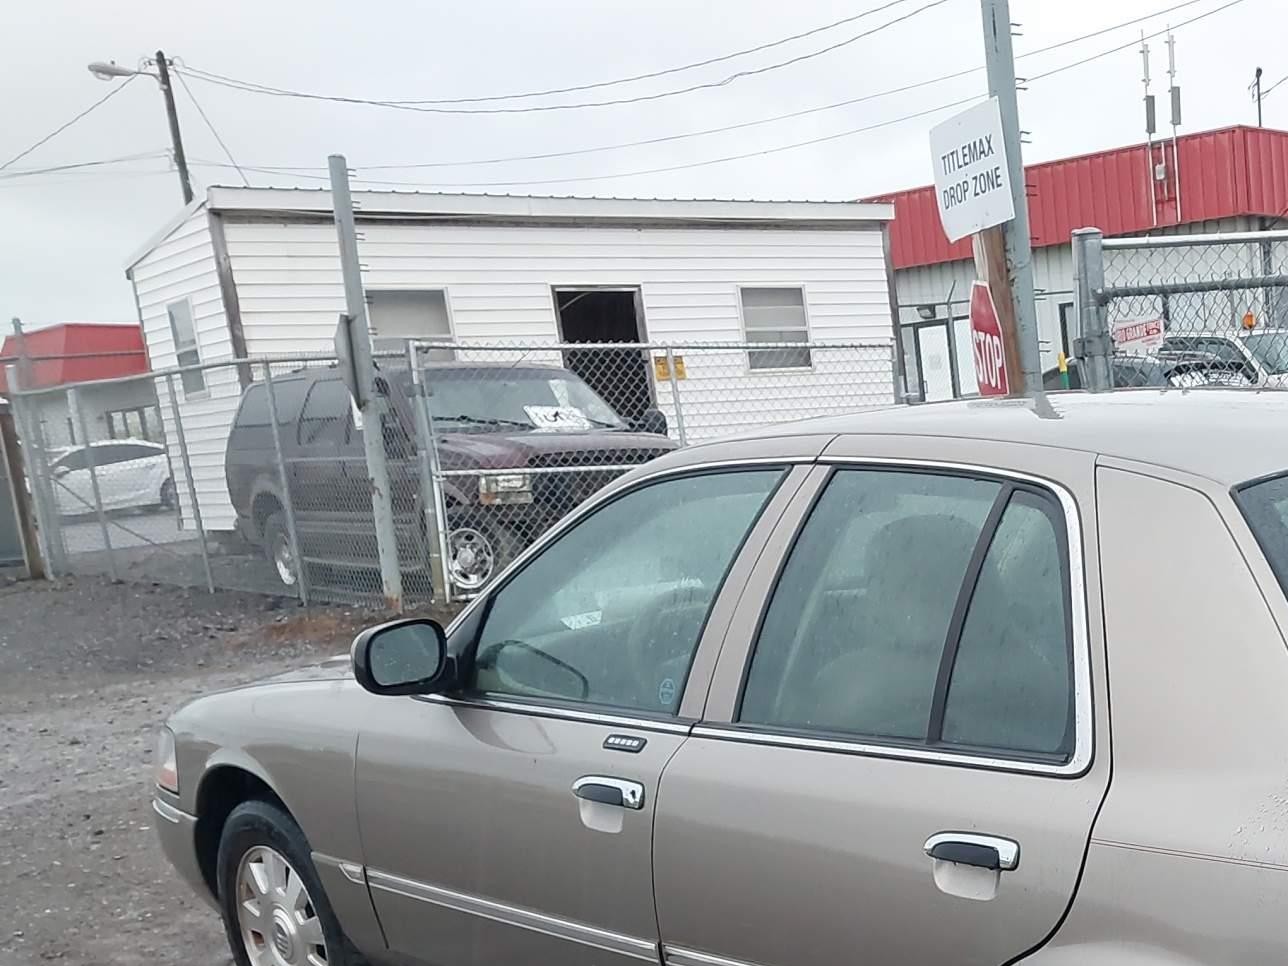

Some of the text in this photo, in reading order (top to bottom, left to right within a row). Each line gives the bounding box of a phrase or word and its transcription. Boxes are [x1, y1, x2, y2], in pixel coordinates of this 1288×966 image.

[941, 133, 994, 175] TITLEMAX
[943, 166, 1003, 210] DROP ZONE
[972, 329, 1003, 390] STOP
